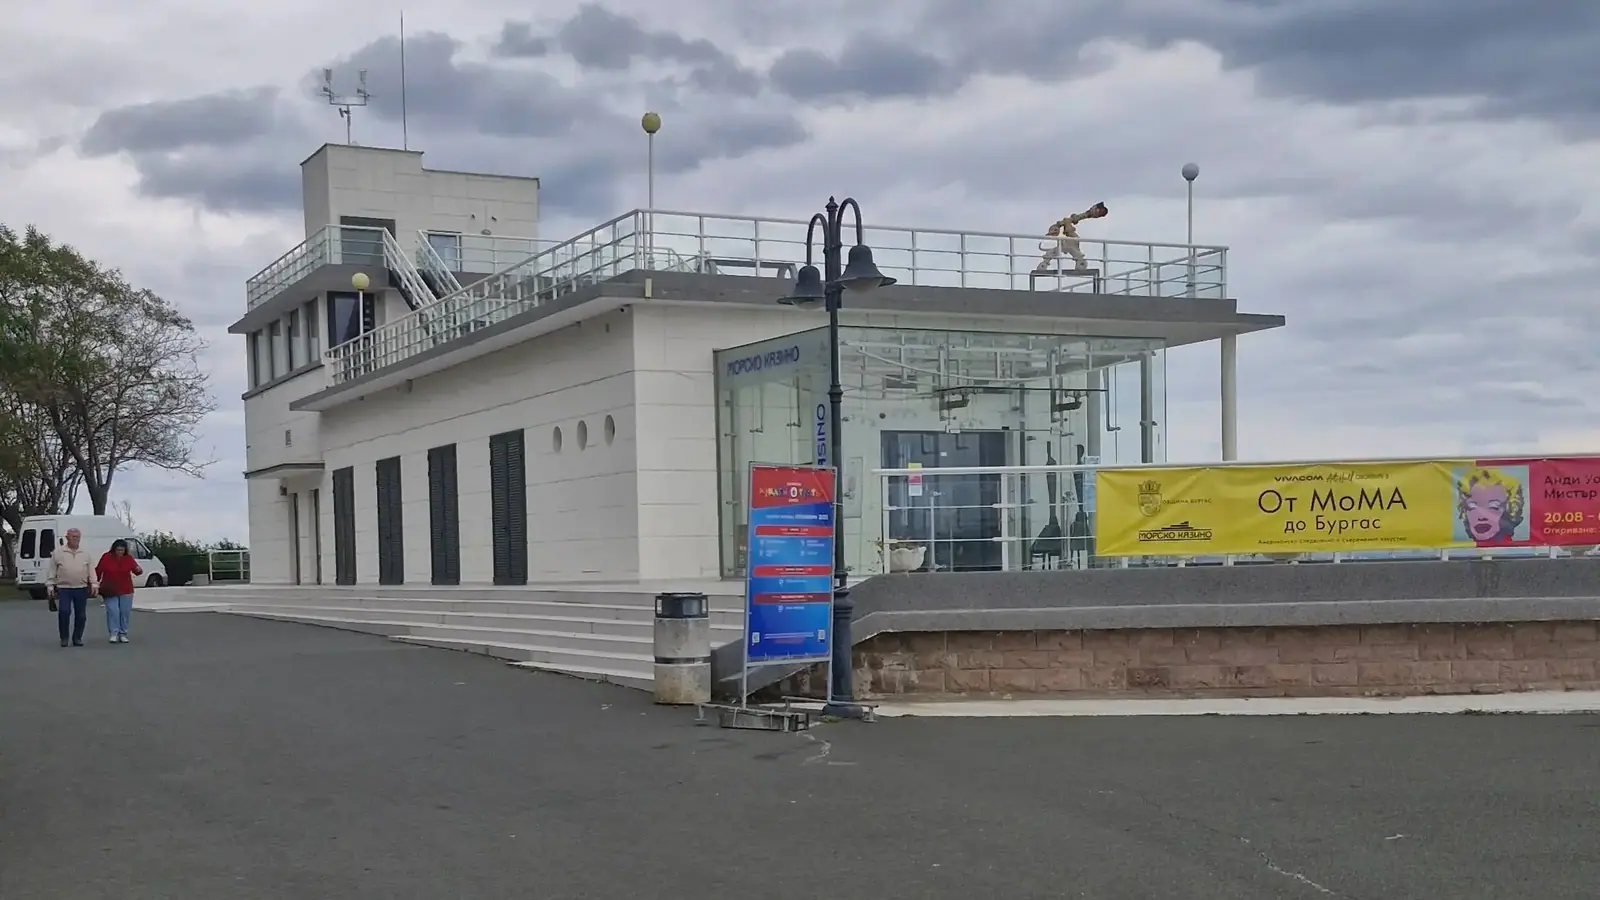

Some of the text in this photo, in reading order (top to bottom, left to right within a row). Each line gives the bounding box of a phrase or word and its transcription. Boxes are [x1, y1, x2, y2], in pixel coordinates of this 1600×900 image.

[727, 354, 762, 377] МОРСКО
[816, 403, 827, 466] ASINO
[1544, 475, 1580, 486] Анди
[1544, 488, 1597, 500] Мистър
[1258, 489, 1298, 514] От
[1543, 511, 1583, 523] 20.08
[1284, 514, 1381, 535] до Бургас
[1138, 531, 1176, 540] МОРСКО
[1543, 527, 1597, 536] Откриване:
